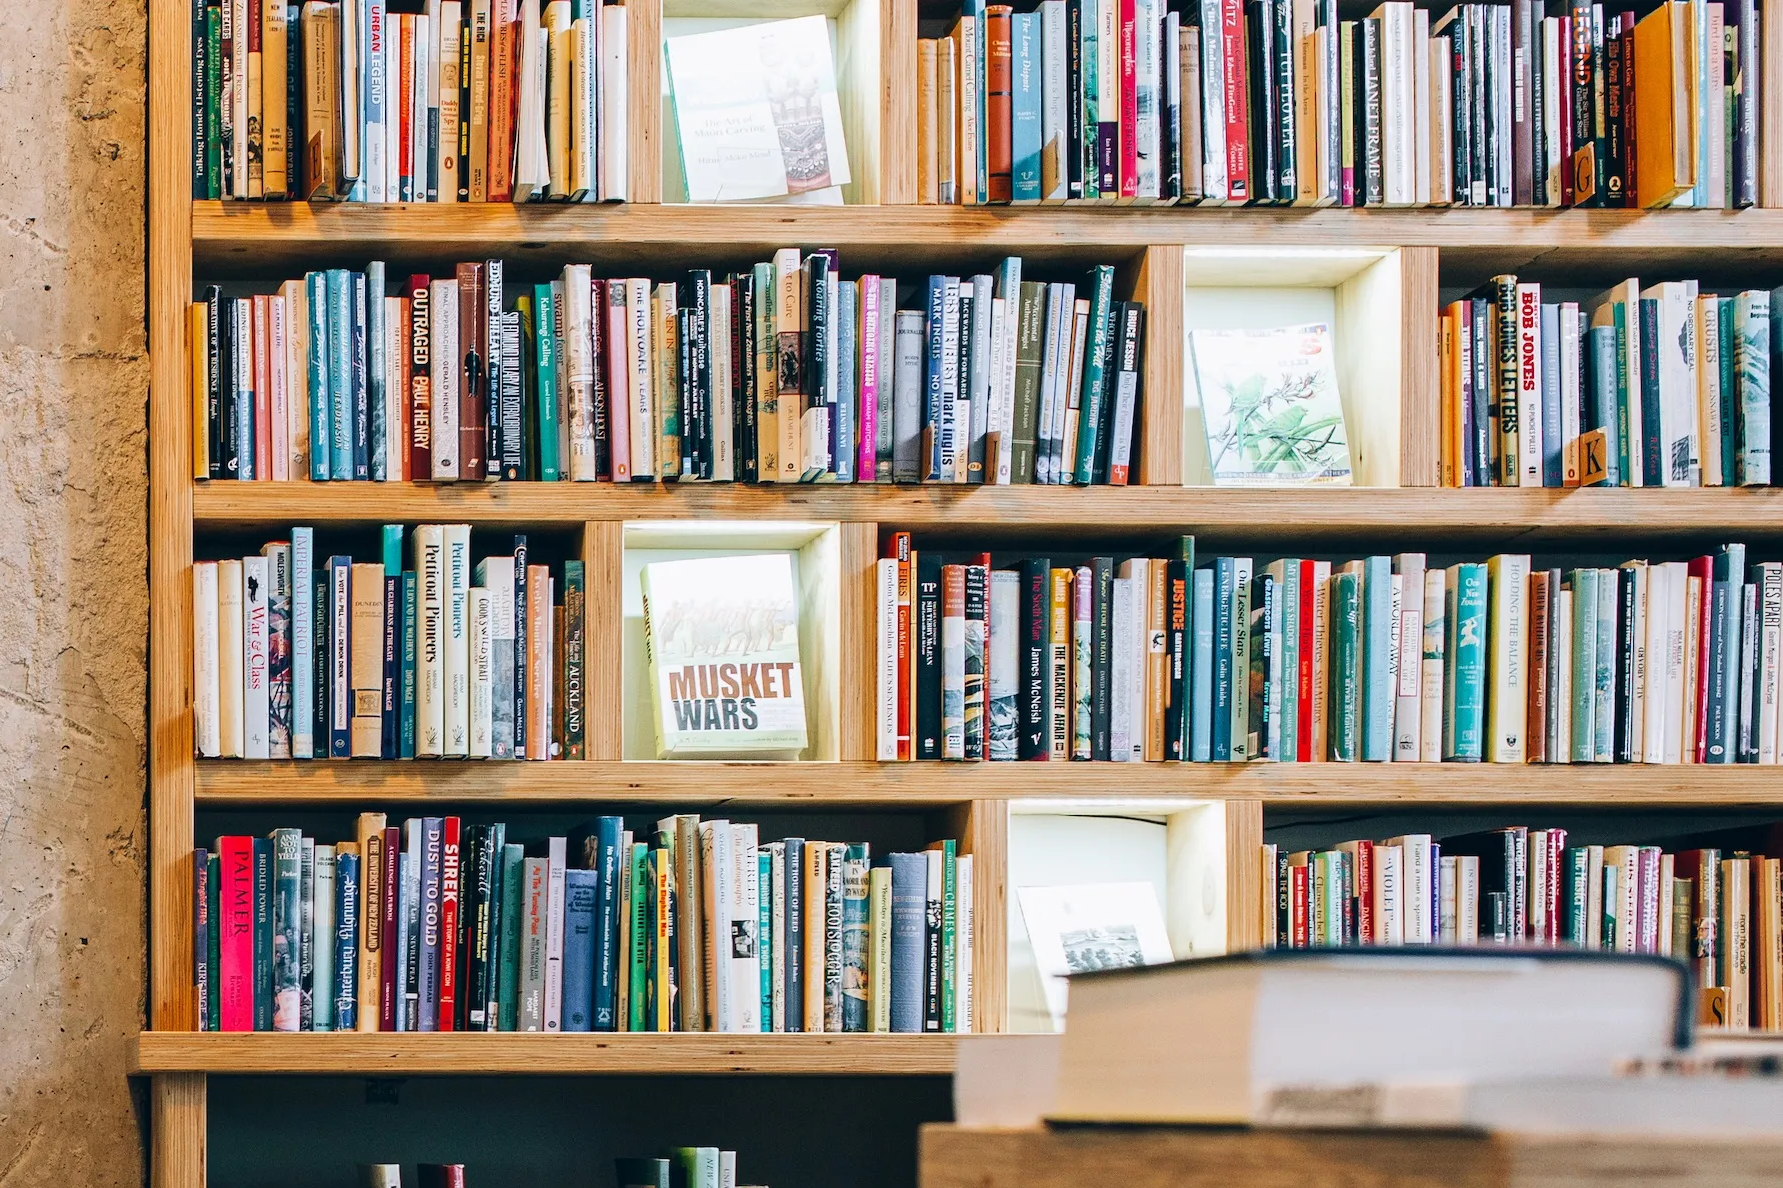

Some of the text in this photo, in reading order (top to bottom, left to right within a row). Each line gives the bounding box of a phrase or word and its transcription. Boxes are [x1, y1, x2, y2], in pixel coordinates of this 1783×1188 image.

[1575, 7, 1589, 86] LEGEND
[1368, 75, 1380, 178] JANET FRAME
[413, 288, 428, 364] OUTRAGED
[814, 279, 826, 362] Roaring Forties
[932, 288, 942, 360] MARK INGLIS
[1124, 310, 1138, 370] BRUCE JESSON
[1499, 283, 1518, 434] BOB JONES LETTERS
[1522, 291, 1535, 391] BOB JONES
[414, 376, 429, 449] PAUL HENRY
[941, 392, 956, 466] mark inglis
[425, 544, 440, 663] Petticoat Pioneers
[451, 541, 465, 639] Petticoat Pioneers
[1173, 579, 1185, 630] JUSTICE
[568, 665, 581, 732] AUCKLAND
[669, 662, 794, 701] MUSKET
[673, 698, 758, 732] WARS
[1030, 646, 1042, 723] James McNeish
[1055, 645, 1066, 740] THE MACKENZIE AFFAIR
[233, 850, 250, 937] PALMER
[425, 830, 440, 946] DUST TO GOLD
[443, 843, 457, 902] SHREK
[943, 892, 955, 932] CRIMES
[929, 933, 938, 995] BLACK NOVEMBER
